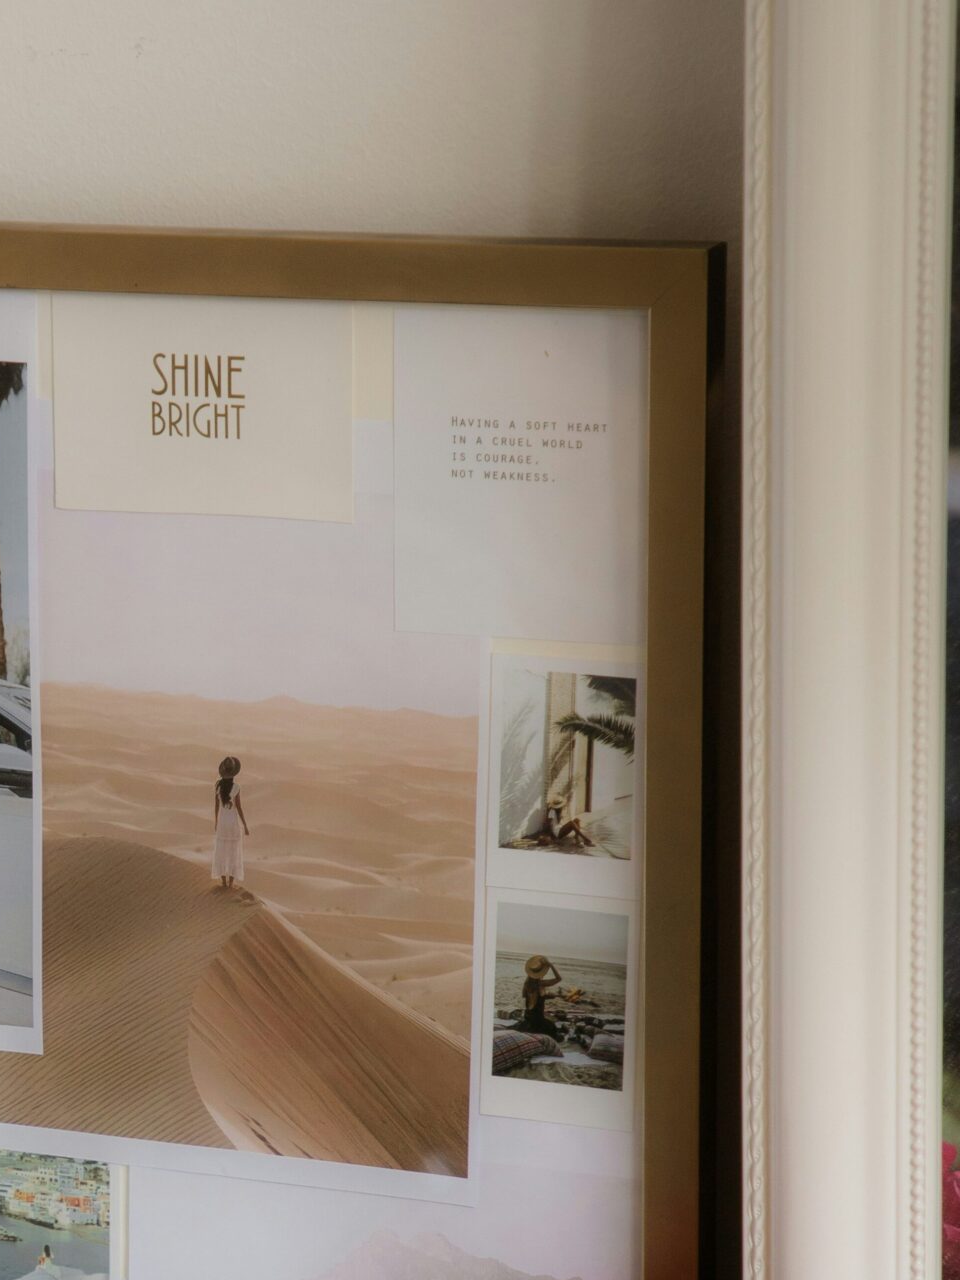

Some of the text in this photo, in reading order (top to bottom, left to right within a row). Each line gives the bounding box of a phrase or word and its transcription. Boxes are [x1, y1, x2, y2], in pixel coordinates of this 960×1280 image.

[151, 352, 246, 399] SHINE
[151, 401, 246, 440] BRIGHT
[451, 416, 608, 433] HAVING A SOFT HEART
[452, 435, 583, 449] IN A CRUEL WORLD
[452, 452, 466, 461] IS
[451, 470, 556, 483] NOT WEAKNESS.
